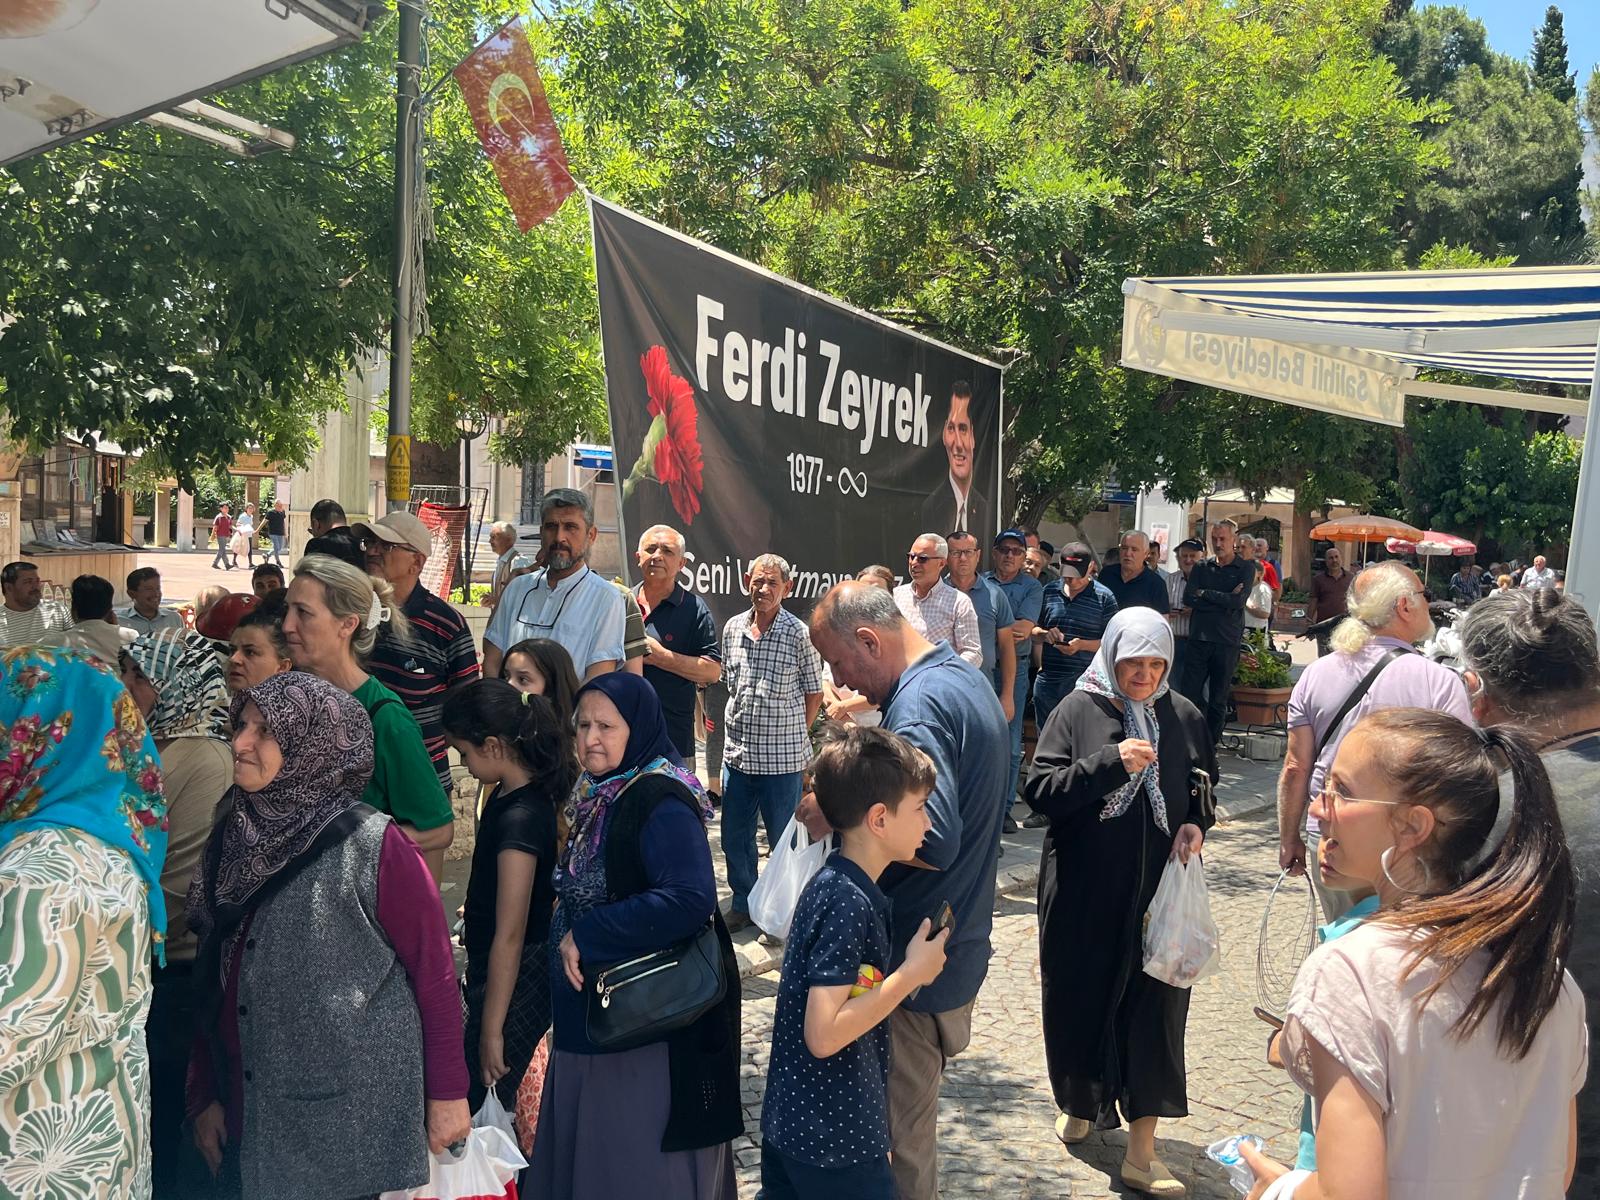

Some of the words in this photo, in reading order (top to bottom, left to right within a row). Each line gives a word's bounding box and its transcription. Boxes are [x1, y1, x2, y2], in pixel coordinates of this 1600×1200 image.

[695, 294, 807, 418] Ferdi
[818, 340, 932, 455] Zeyrek
[786, 452, 823, 495] 1977
[677, 551, 731, 595] Seni
